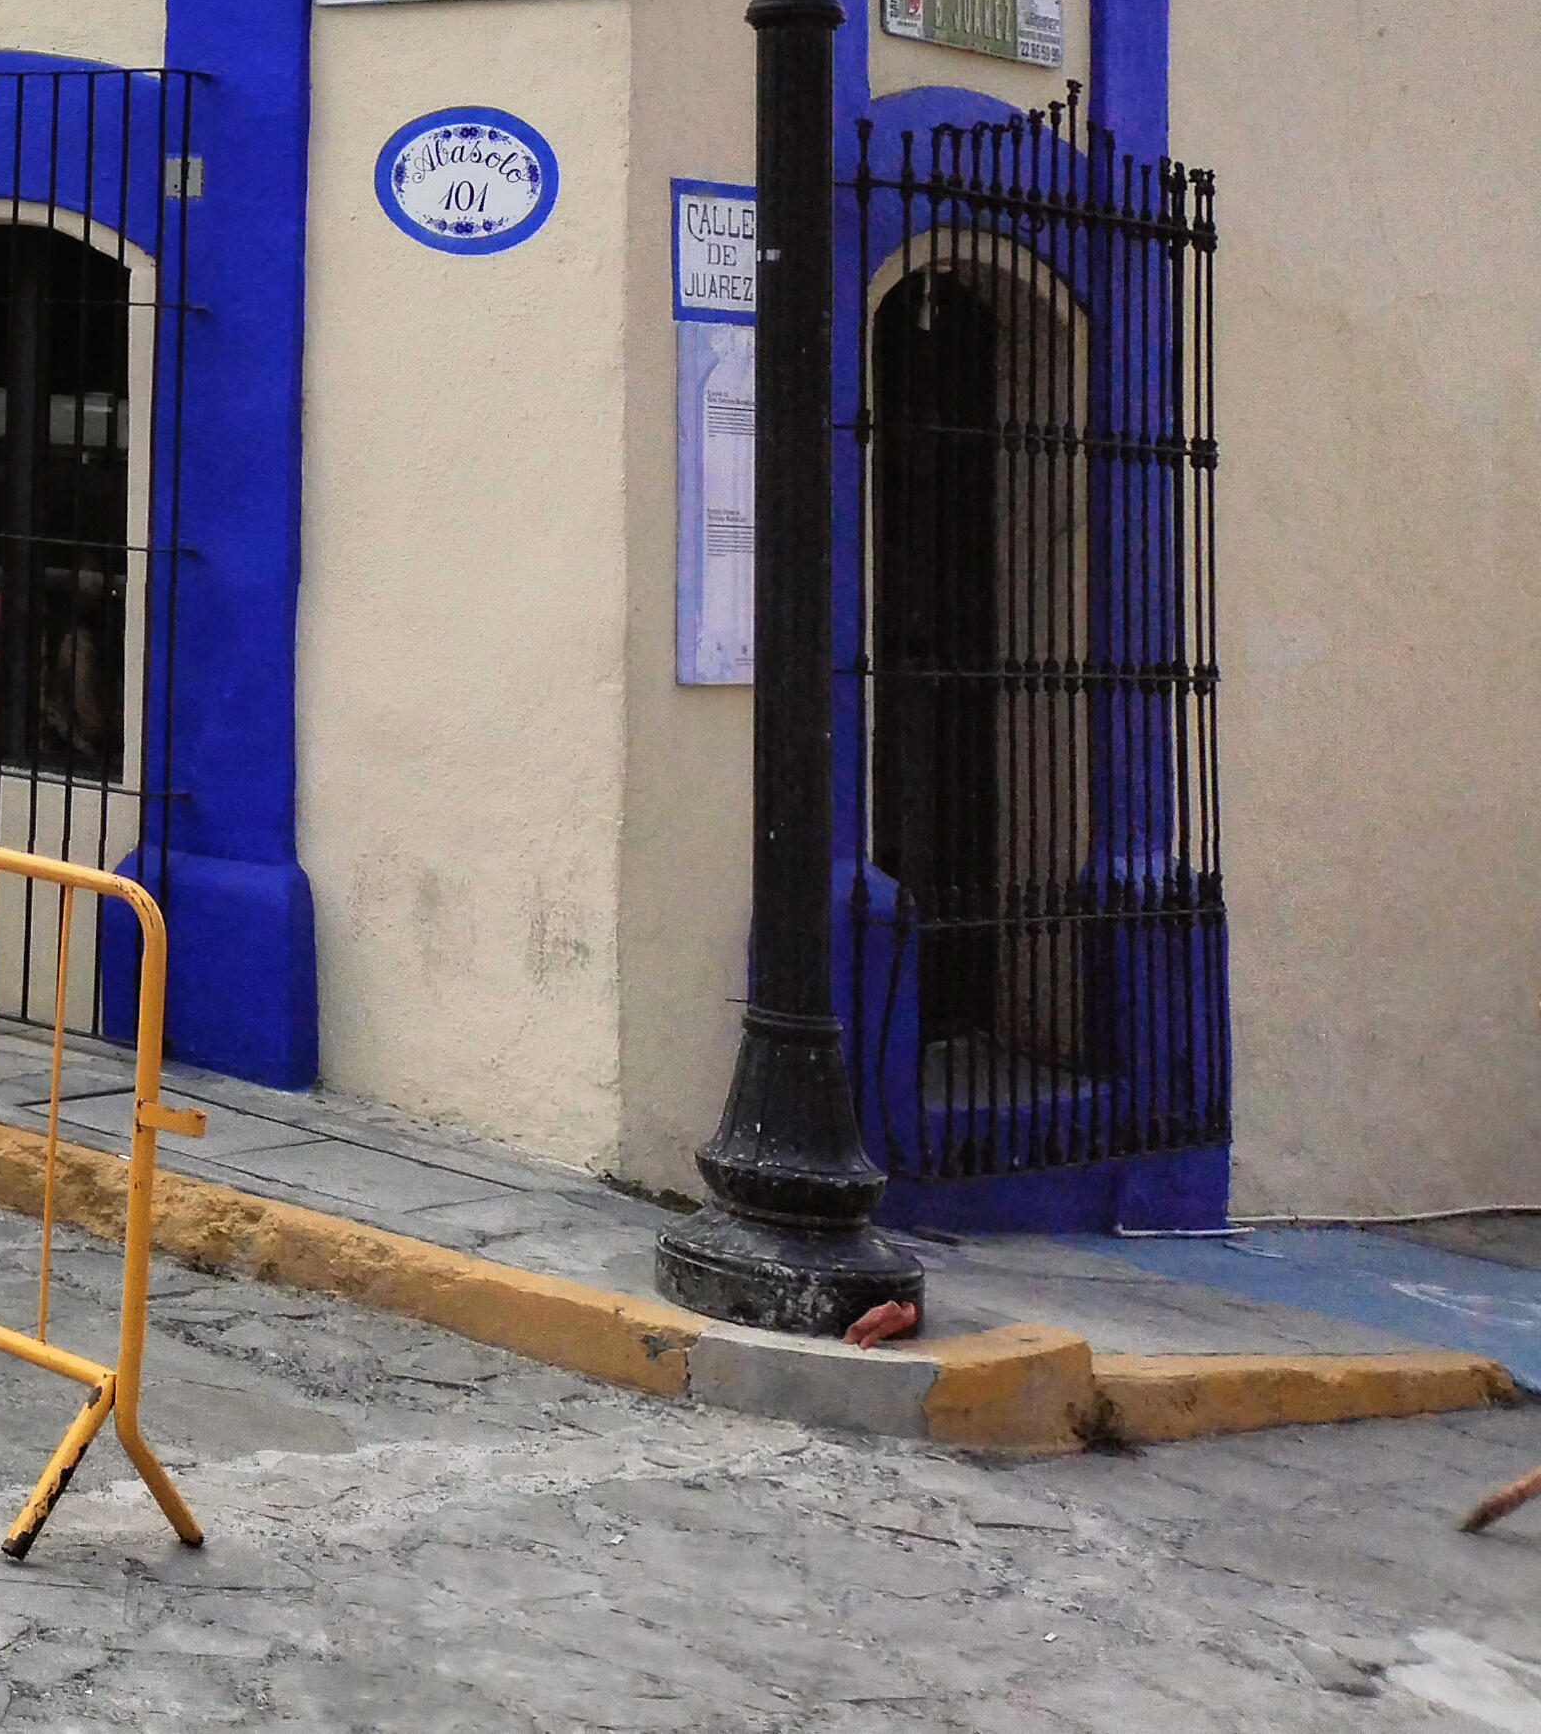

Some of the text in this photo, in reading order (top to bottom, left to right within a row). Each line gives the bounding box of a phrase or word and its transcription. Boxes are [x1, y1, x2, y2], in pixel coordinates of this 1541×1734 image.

[411, 138, 530, 184] Abasolo
[437, 180, 489, 213] 101
[687, 203, 755, 243] CALLE
[706, 242, 737, 267] DE
[684, 272, 754, 302] JUAREZ
